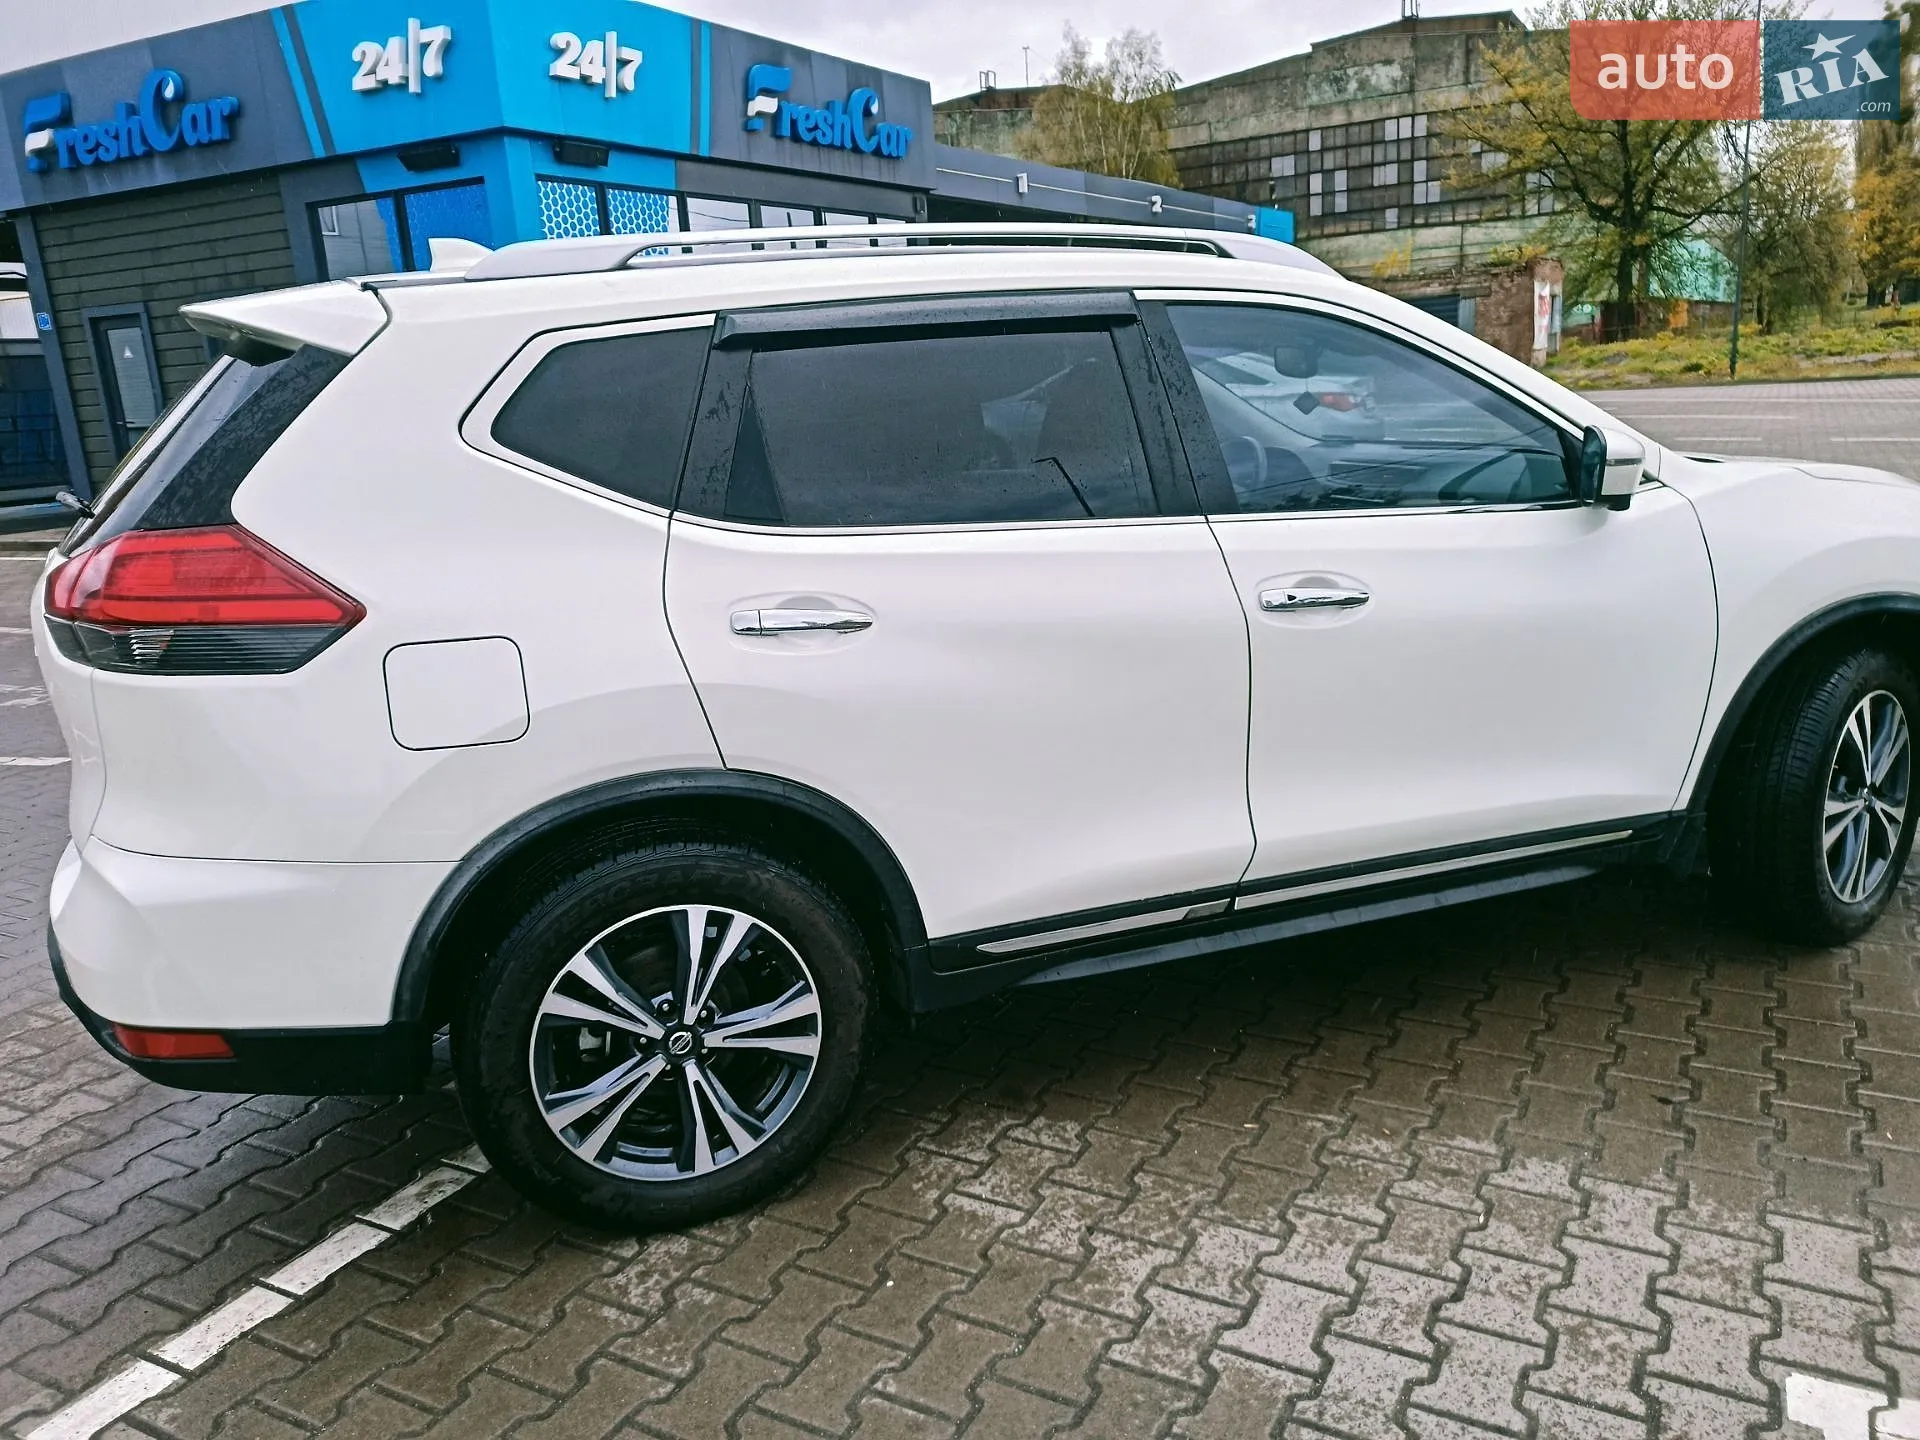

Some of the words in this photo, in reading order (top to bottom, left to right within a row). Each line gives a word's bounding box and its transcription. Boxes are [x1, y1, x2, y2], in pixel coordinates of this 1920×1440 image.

[24, 68, 240, 172] FreshCar
[745, 63, 912, 160] FreshCar
[1151, 195, 1163, 213] 2
